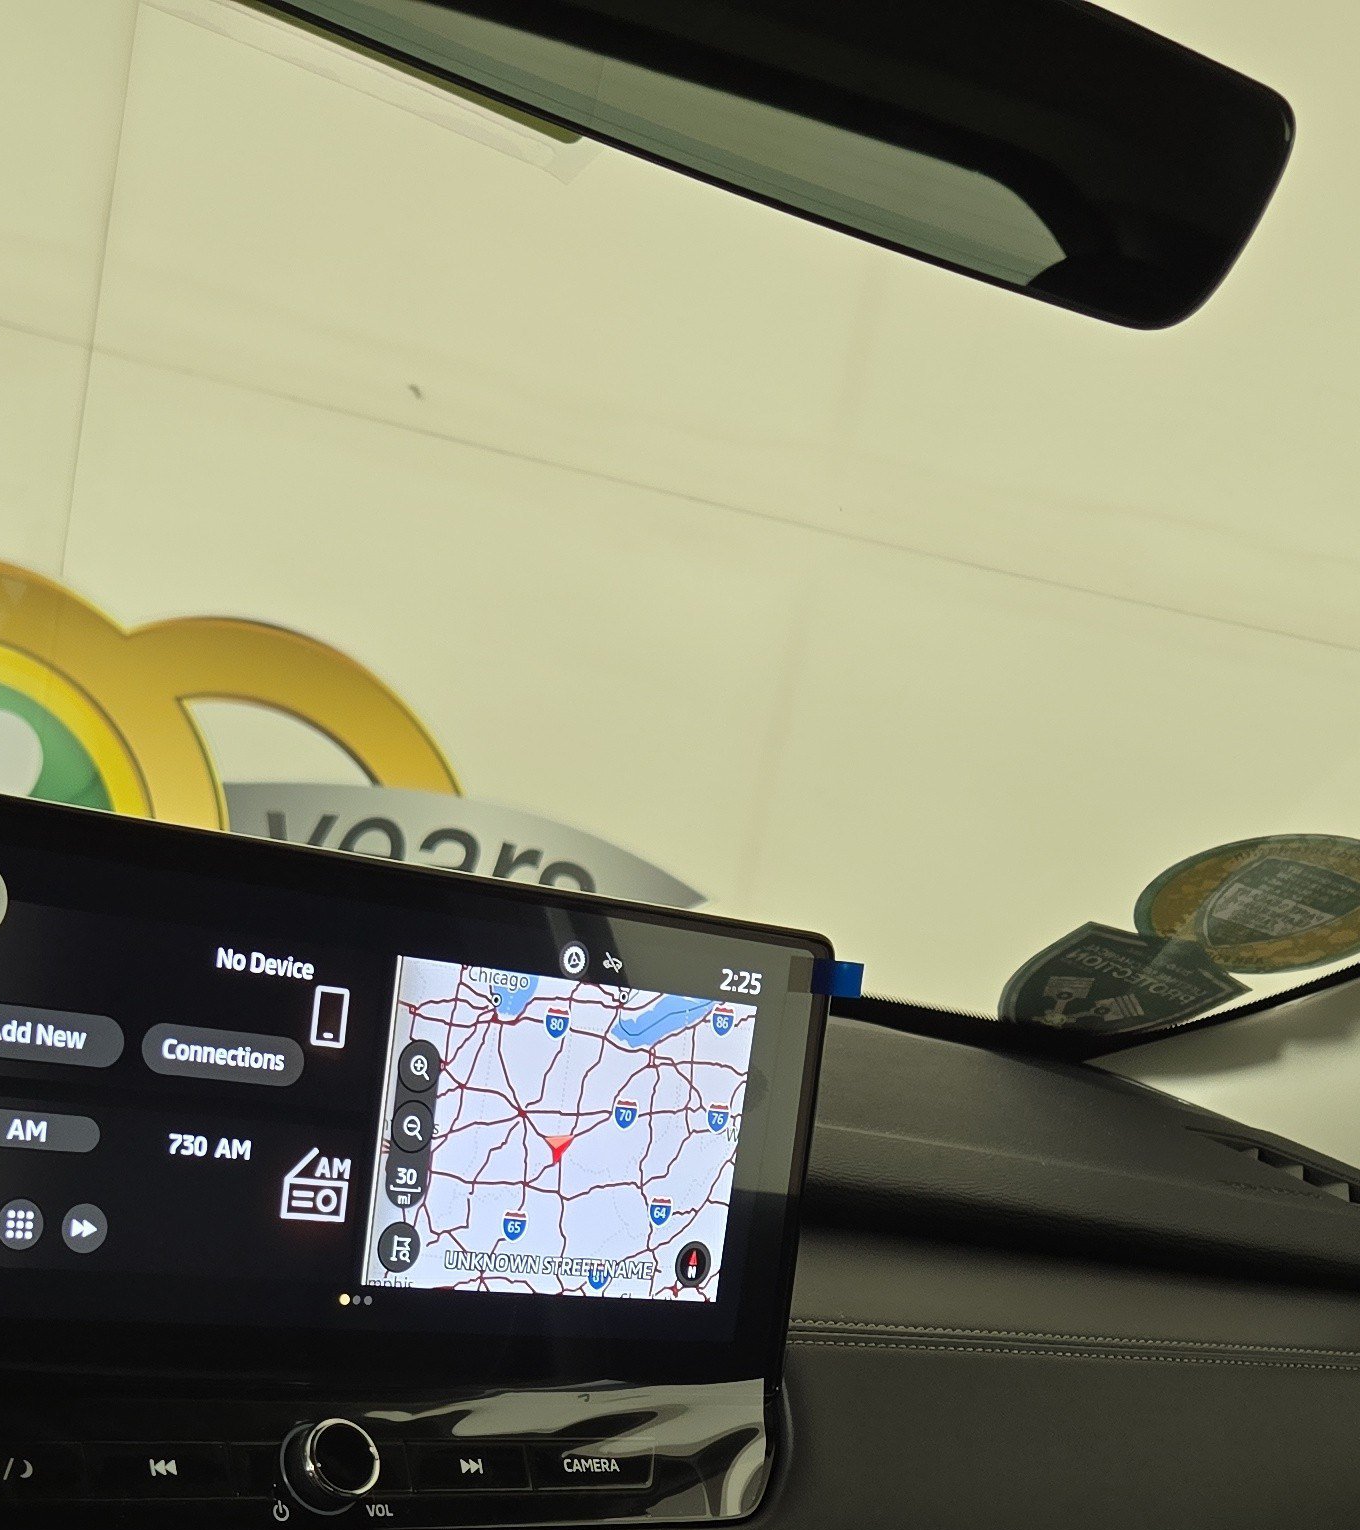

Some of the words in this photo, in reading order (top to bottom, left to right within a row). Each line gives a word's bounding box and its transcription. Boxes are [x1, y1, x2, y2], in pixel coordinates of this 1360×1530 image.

[215, 947, 245, 972] No
[250, 951, 315, 980] Device
[467, 966, 529, 989] Chicago
[719, 968, 762, 994] 2:25
[550, 1018, 563, 1031] 80
[716, 1016, 729, 1029] 86
[36, 1022, 87, 1050] New
[162, 1038, 285, 1071] Connections
[619, 1109, 632, 1122] 70
[712, 1112, 724, 1125] 76
[6, 1119, 48, 1143] AM
[169, 1133, 207, 1156] 730
[214, 1138, 251, 1160] AM
[315, 1156, 350, 1179] AM
[396, 1168, 418, 1185] 30
[398, 1194, 411, 1204] mi
[654, 1206, 666, 1219] 64
[507, 1222, 520, 1234] 65
[444, 1250, 540, 1274] UNKNOWN
[541, 1255, 604, 1277] STREET
[605, 1259, 658, 1280] NAME
[688, 1265, 696, 1278] N
[563, 1458, 620, 1474] CAMERA
[366, 1504, 394, 1519] VOL
